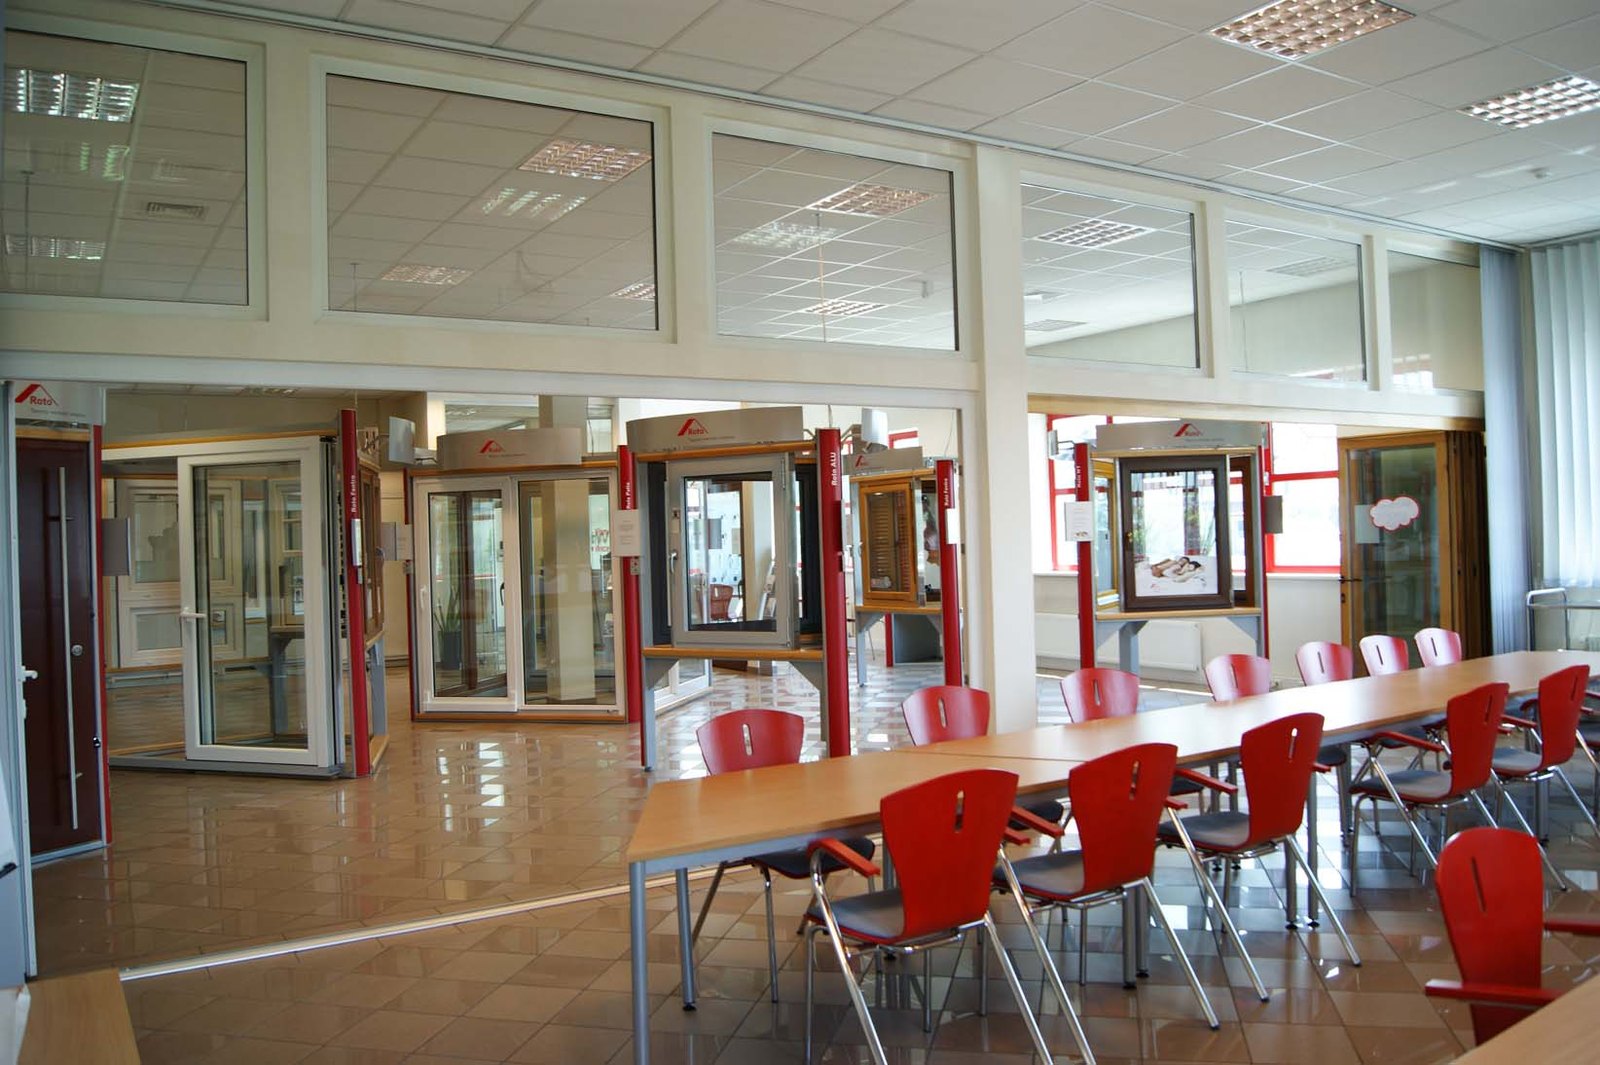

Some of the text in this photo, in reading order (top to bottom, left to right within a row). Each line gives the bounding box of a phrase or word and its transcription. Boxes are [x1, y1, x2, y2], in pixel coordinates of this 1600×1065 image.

[30, 396, 53, 406] Roto
[687, 427, 705, 435] Roto
[831, 468, 839, 486] Roto
